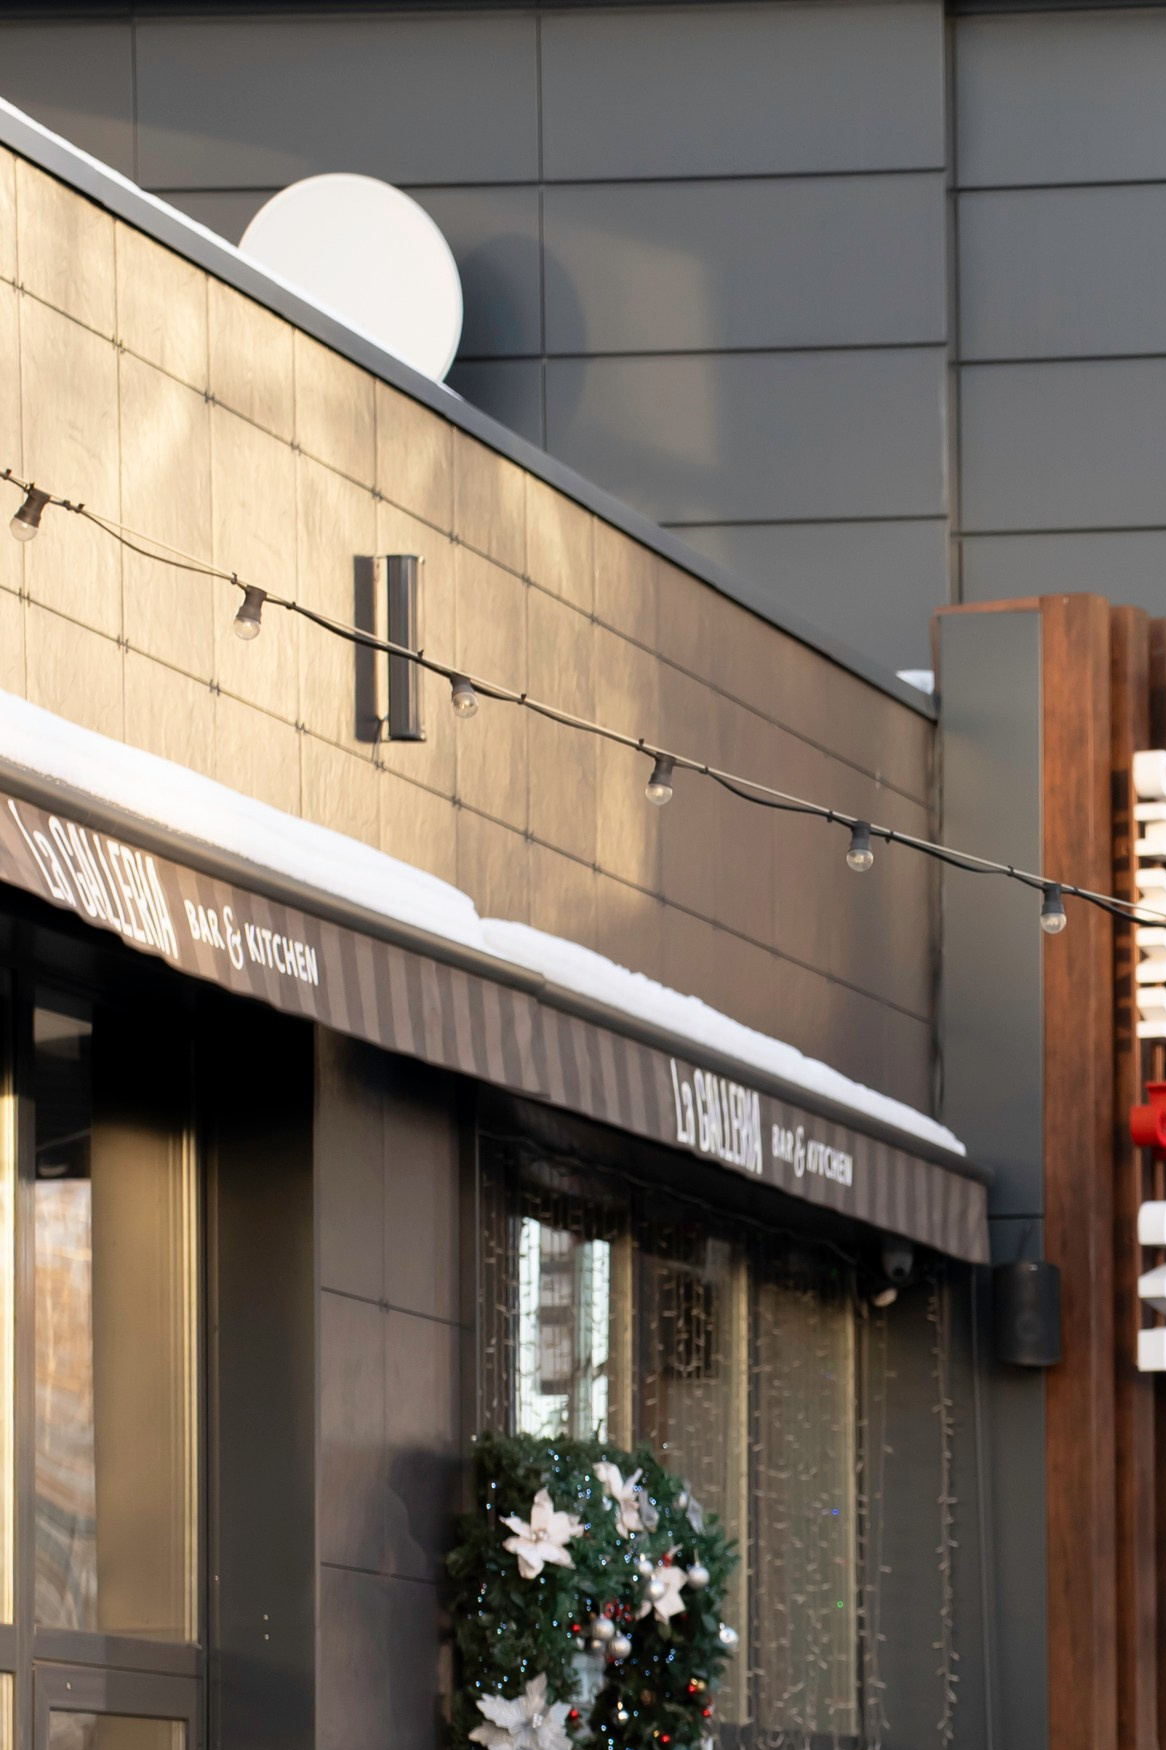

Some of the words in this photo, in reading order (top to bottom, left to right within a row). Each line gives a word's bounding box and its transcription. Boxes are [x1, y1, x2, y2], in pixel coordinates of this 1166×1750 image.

[8, 799, 76, 907] La
[49, 815, 179, 960] GALLERIA
[184, 899, 225, 950] BAR
[223, 905, 244, 970] &
[245, 922, 319, 986] KITCHEN
[670, 1057, 695, 1147] La
[694, 1068, 763, 1175] GALLERIA
[772, 1124, 794, 1164] BAR
[806, 1139, 853, 1187] KITCHEN
